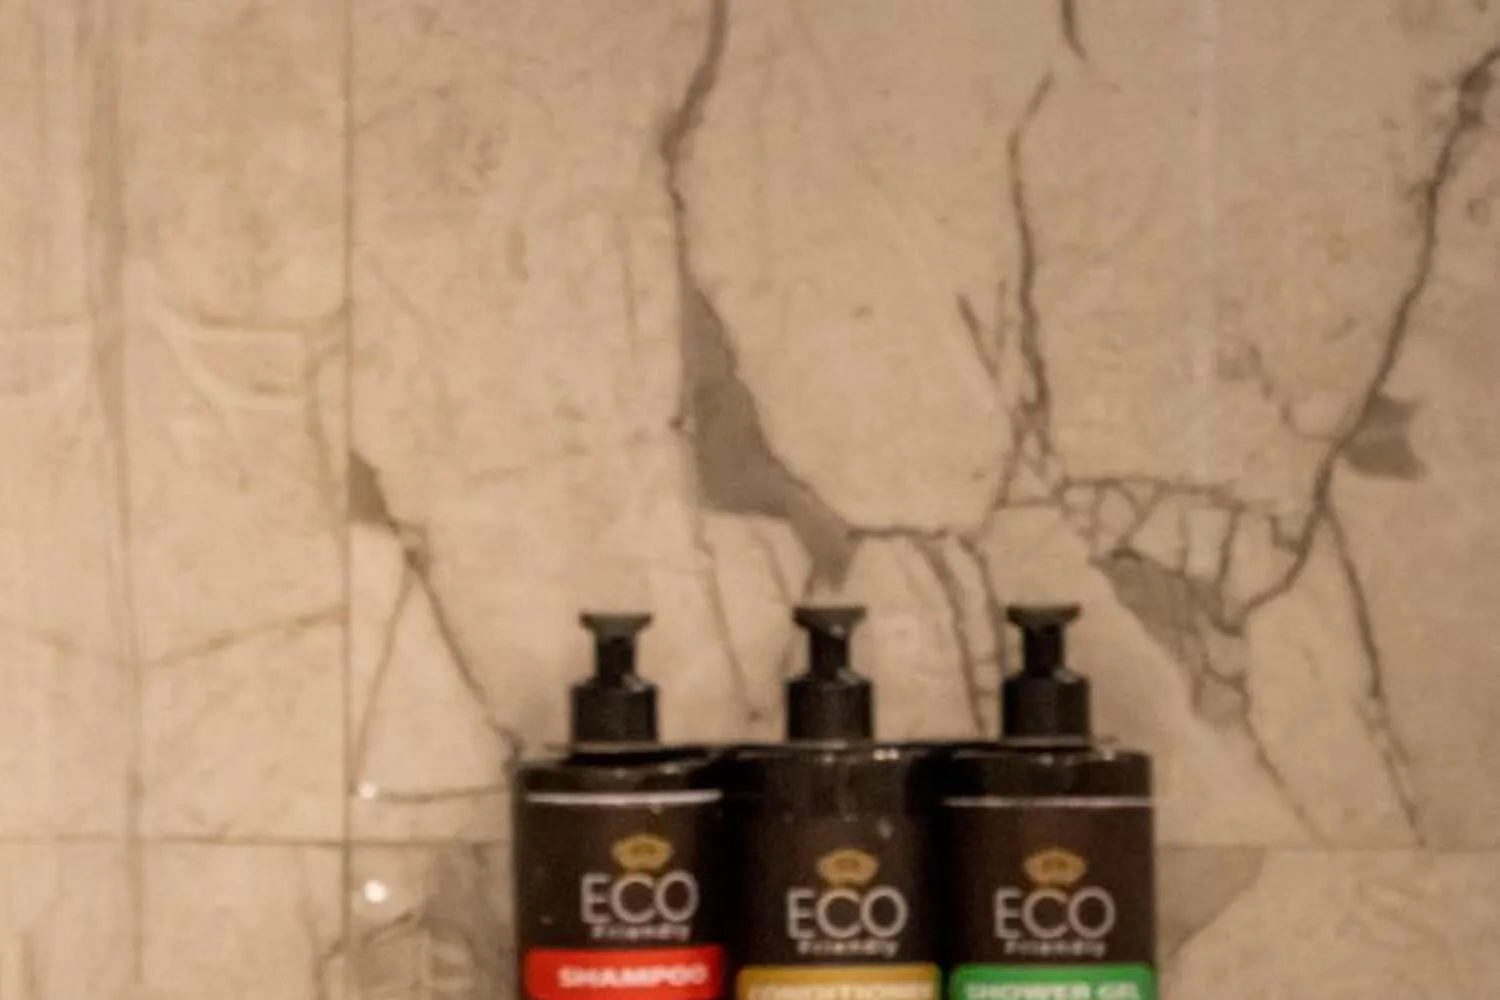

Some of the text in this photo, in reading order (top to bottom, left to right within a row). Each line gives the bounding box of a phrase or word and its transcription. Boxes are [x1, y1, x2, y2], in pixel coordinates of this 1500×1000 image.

[580, 870, 698, 925] ECO
[785, 885, 908, 940] ECO
[995, 886, 1116, 940] ECO
[556, 963, 709, 988] SHAMPOO
